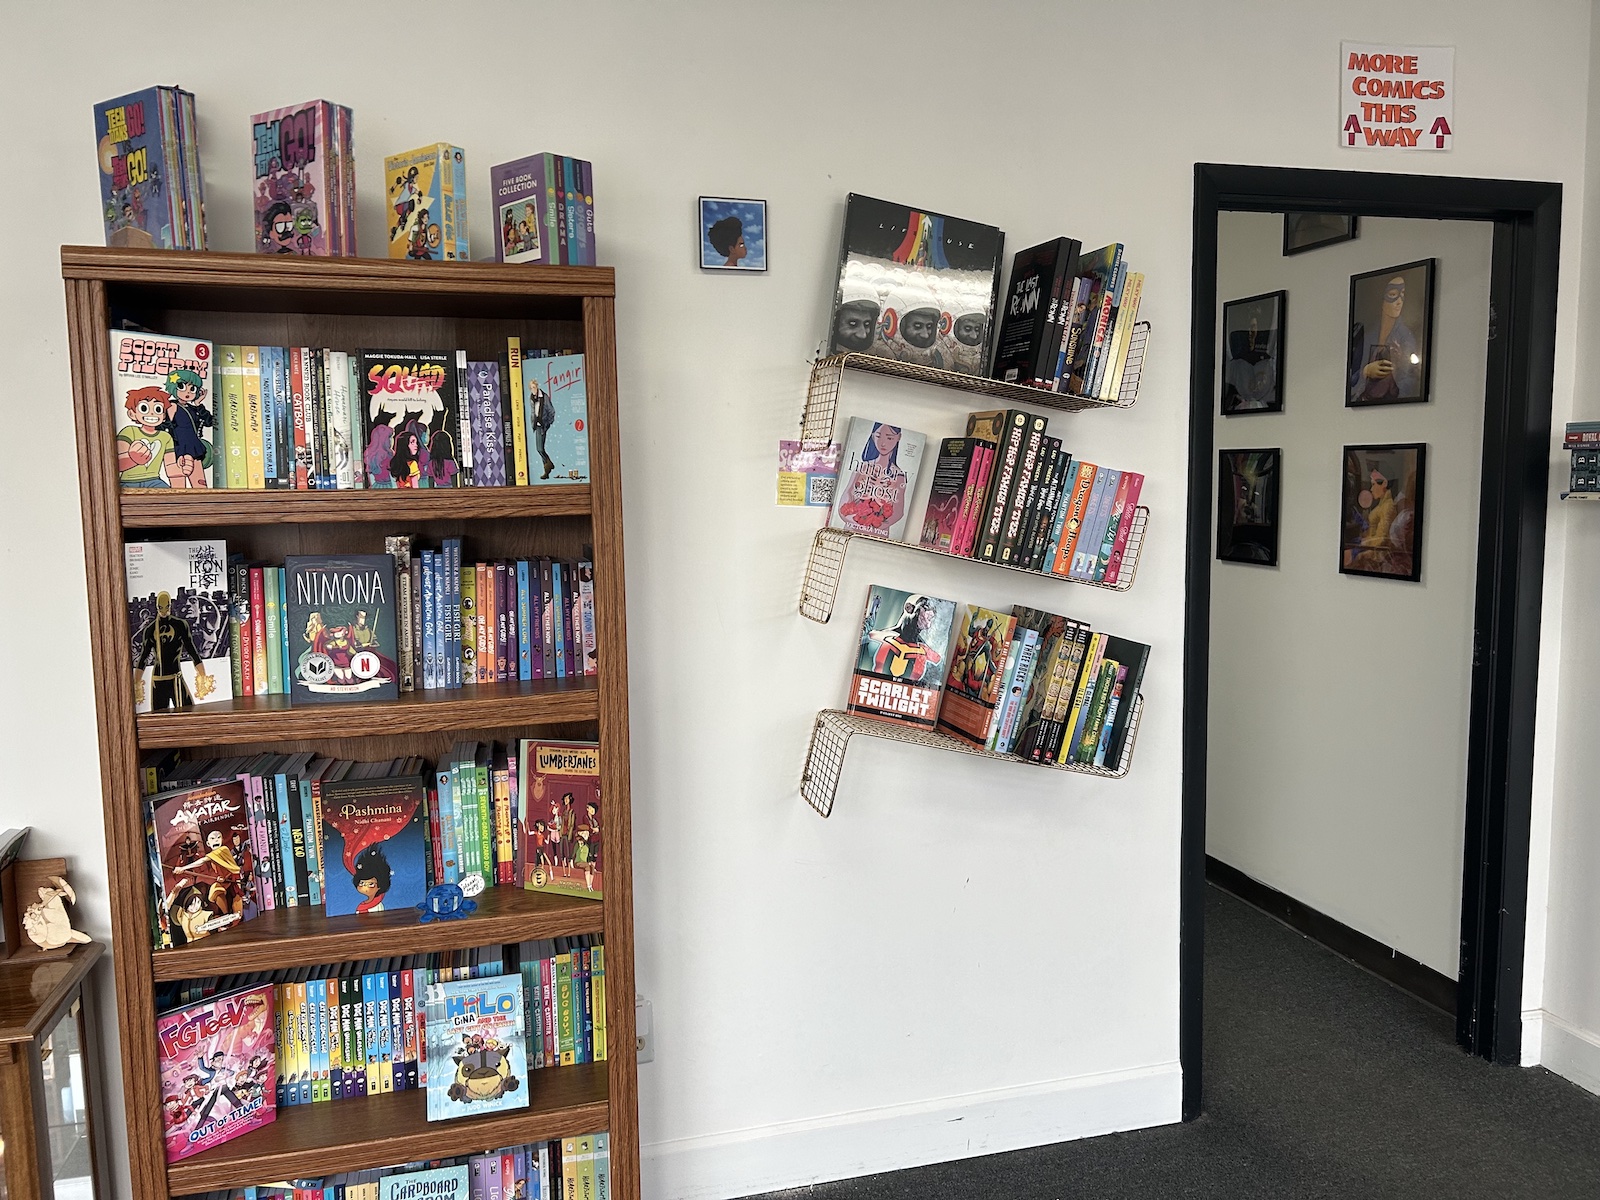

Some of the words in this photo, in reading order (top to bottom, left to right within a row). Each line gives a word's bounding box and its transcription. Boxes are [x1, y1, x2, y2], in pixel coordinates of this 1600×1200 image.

[1348, 53, 1418, 74] MORE
[1352, 76, 1445, 99] COMICS
[105, 106, 126, 130] TEEN
[126, 102, 146, 139] GO!
[1361, 102, 1417, 123] THIS
[254, 120, 280, 156] TEEN
[280, 106, 316, 171] GO!
[1363, 127, 1423, 147] WAY
[498, 179, 538, 196] COLLECTION
[502, 176, 515, 187] FIVE
[515, 173, 532, 184] BOOK
[558, 202, 567, 247] DRAMA
[1113, 248, 1123, 268] DANIEL
[1016, 281, 1024, 294] THE
[1025, 274, 1040, 290] LAST
[1109, 268, 1119, 289] CLOWES
[1009, 288, 1041, 316] RONIN
[1095, 295, 1114, 344] MONICA
[119, 337, 180, 359] SCOTT
[198, 346, 206, 358] 3
[1066, 327, 1083, 366] SUNSHINE
[118, 352, 208, 379] PILGRIM
[510, 347, 520, 369] RUN
[367, 362, 448, 396] SQUAD
[292, 393, 304, 431] CATBOY
[482, 383, 495, 429] Paradise
[486, 430, 497, 453] Kiss
[1050, 449, 1058, 461] LIU
[848, 451, 915, 485] hungry
[854, 477, 899, 503] ghost
[996, 465, 1014, 505] FAMILY
[1014, 469, 1033, 510] FAMILY
[1059, 492, 1071, 520] PHANTOM
[1074, 479, 1091, 522] Dragon
[845, 522, 874, 534] VICTORIA
[873, 528, 889, 537] YING
[1055, 521, 1063, 536] TWIN
[1119, 526, 1129, 544] Ball
[1061, 529, 1077, 560] Hoops
[188, 558, 224, 574] IRON
[189, 573, 220, 588] FIST
[296, 571, 386, 605] NIMONA
[268, 614, 277, 639] Smile
[583, 610, 592, 632] JUNIOR
[584, 632, 594, 649] HIGH
[361, 658, 370, 672] N
[1020, 643, 1034, 665] THREE
[1015, 665, 1028, 684] ROCKS
[859, 677, 933, 701] SCARLET
[1073, 687, 1085, 709] ILLEGAL
[858, 690, 930, 717] TWILIGHT
[1106, 698, 1119, 727] INVISIBLE
[539, 753, 597, 770] LUMBERJANES
[169, 799, 241, 826] AVATAR
[314, 800, 322, 829] AMERICAN
[338, 803, 403, 820] Pashmina
[479, 795, 488, 841] SEVENTH-GRADE
[291, 828, 302, 845] NEW
[293, 845, 304, 858] KID
[378, 999, 388, 1014] DOG
[391, 997, 401, 1012] DOG
[404, 996, 413, 1011] DOG
[561, 984, 569, 1008] BUG
[329, 1005, 338, 1020] DOG
[341, 1003, 351, 1018] DOG
[353, 1002, 363, 1017] DOG
[365, 1000, 375, 1015] DOG
[405, 1011, 413, 1025] MAN
[159, 998, 247, 1060] FGTeeV
[330, 1020, 339, 1033] MAN
[342, 1018, 351, 1032] MAN
[354, 1016, 363, 1030] MAN
[366, 1015, 375, 1029] MAN
[379, 1013, 388, 1027] MAN
[392, 1012, 401, 1026] MAN
[562, 1009, 570, 1037] BOYS
[189, 1121, 216, 1143] OUT
[217, 1115, 228, 1128] OF
[229, 1097, 263, 1120] TIME!
[390, 1177, 459, 1200] CARDBOARD
